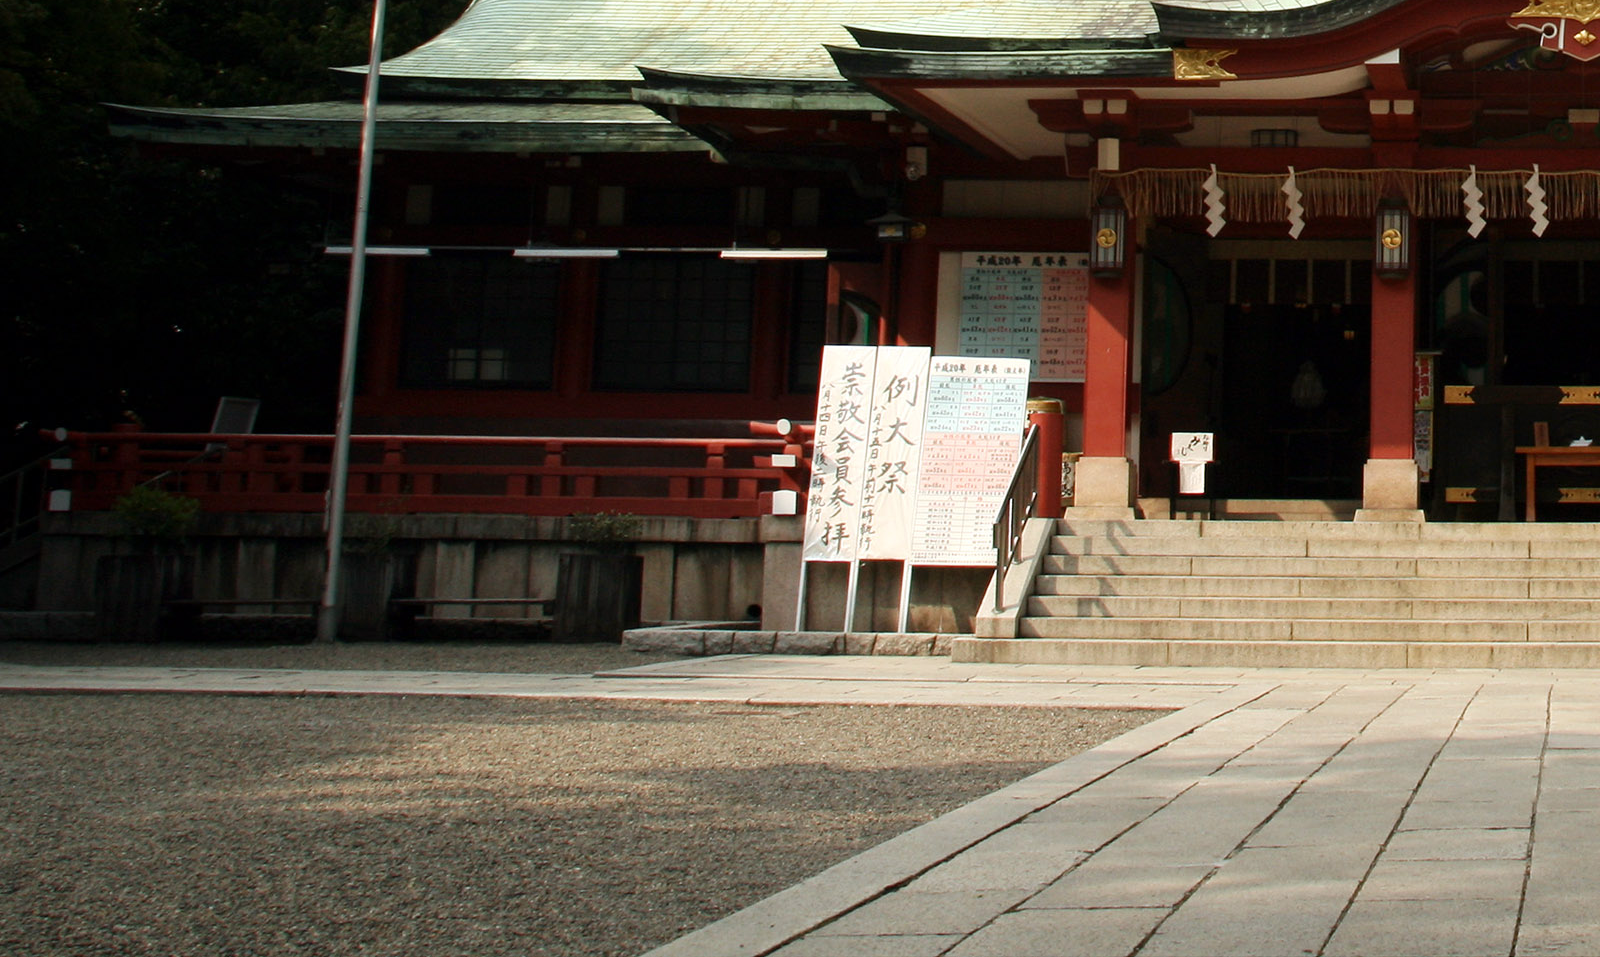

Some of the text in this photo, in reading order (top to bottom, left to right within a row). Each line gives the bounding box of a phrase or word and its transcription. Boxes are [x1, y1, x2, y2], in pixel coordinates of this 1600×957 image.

[934, 362, 967, 374] 平成20年
[820, 361, 866, 556] 崇敬会員参拝
[876, 373, 919, 495] 例大祭
